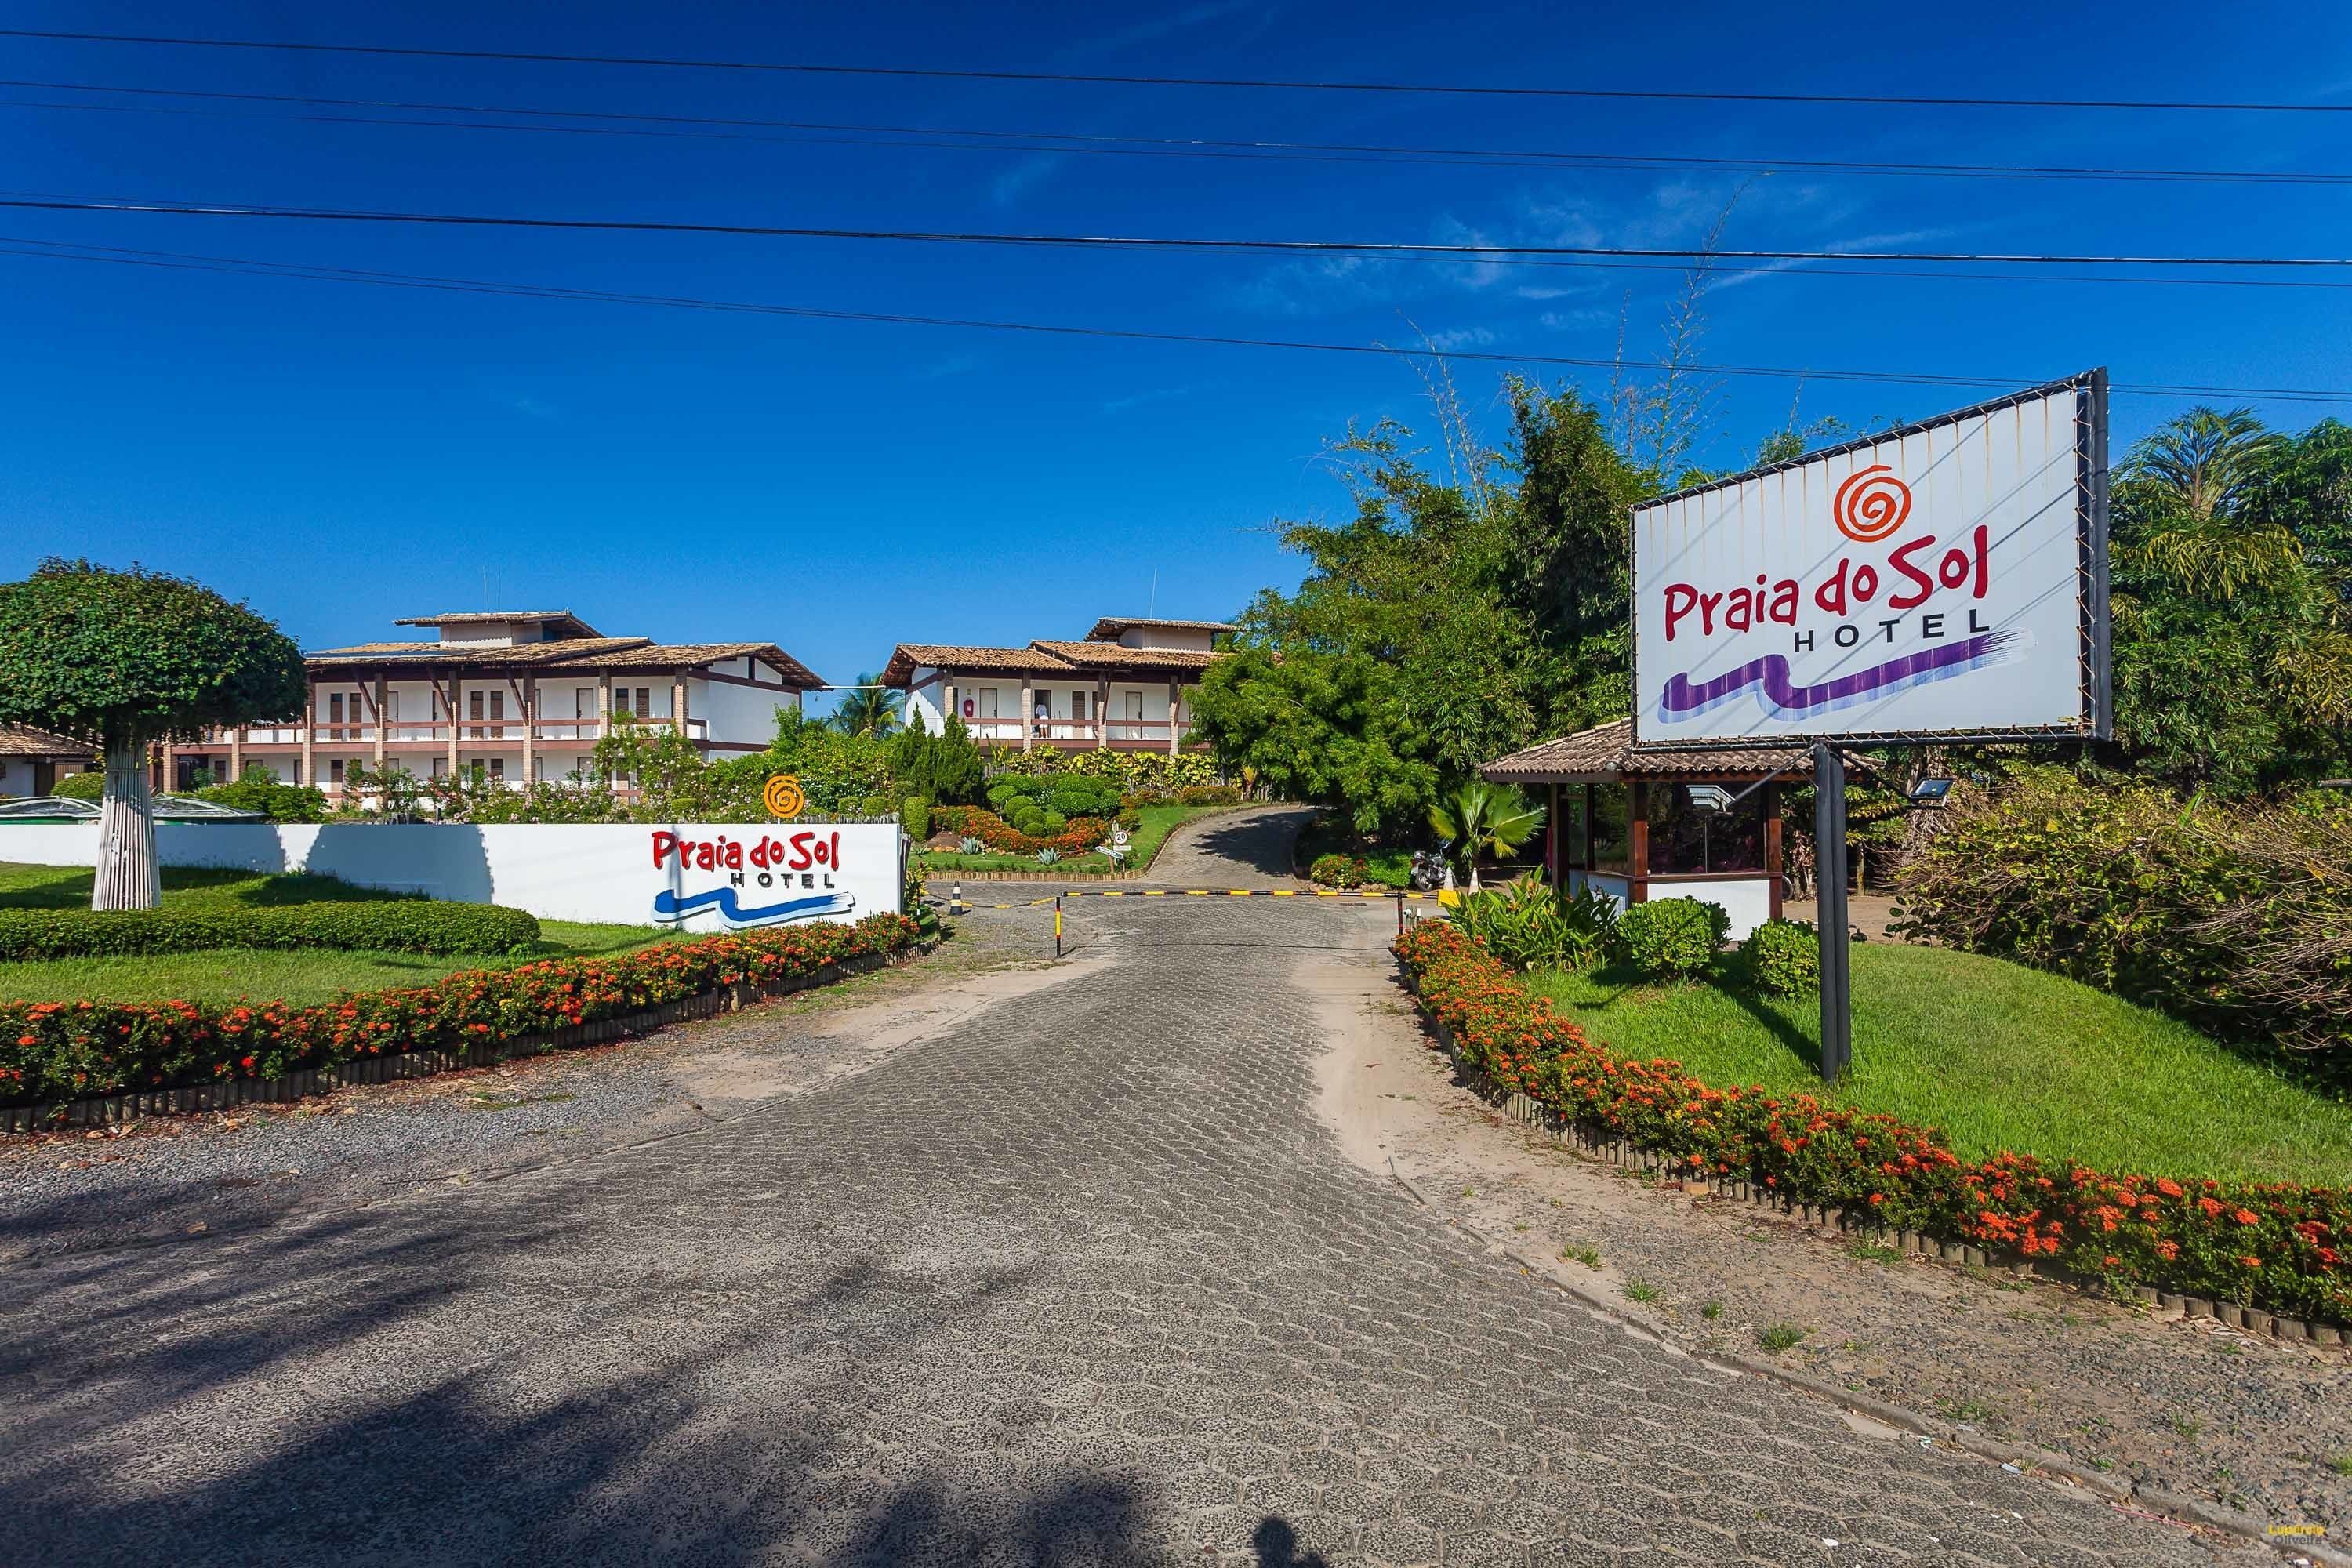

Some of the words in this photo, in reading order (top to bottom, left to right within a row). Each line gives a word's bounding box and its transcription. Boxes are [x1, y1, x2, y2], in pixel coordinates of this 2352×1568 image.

[1664, 574, 1799, 641] Praia
[1814, 557, 1878, 616] do
[1888, 524, 1988, 610] Sol
[1794, 608, 1991, 654] HOTEL
[652, 831, 743, 871] Praia
[750, 835, 785, 871] do
[789, 831, 840, 871] Sol
[731, 872, 835, 889] HOTEL
